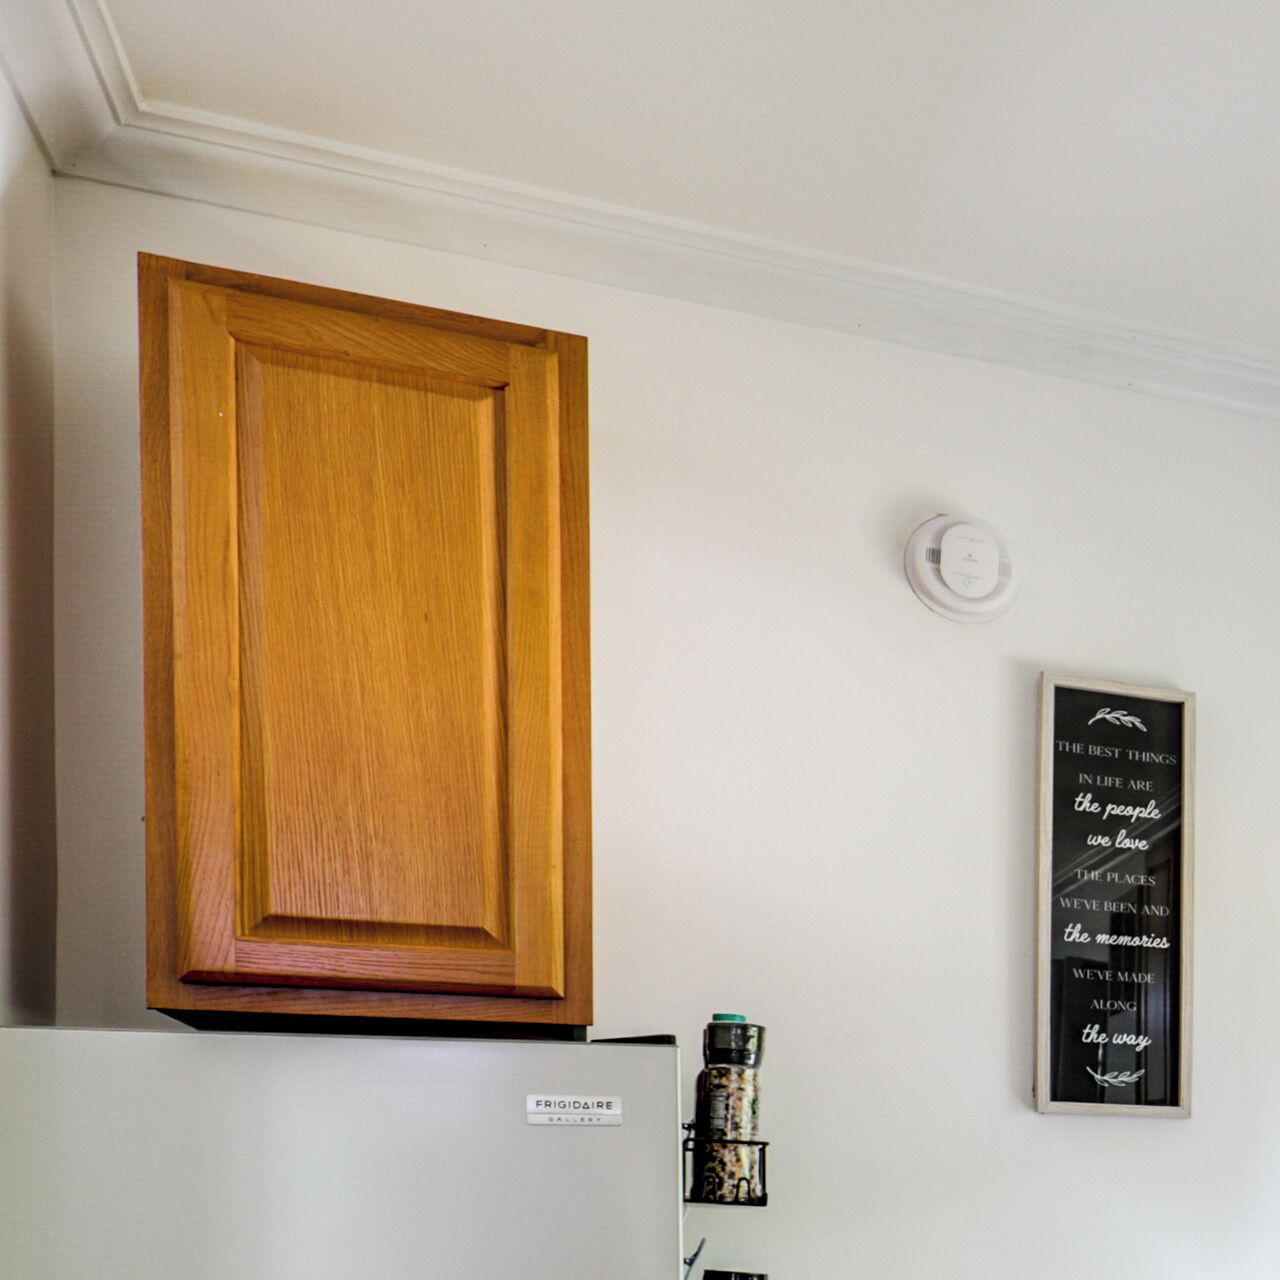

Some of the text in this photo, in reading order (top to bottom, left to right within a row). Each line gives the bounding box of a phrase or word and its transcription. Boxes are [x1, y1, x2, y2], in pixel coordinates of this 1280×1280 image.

[1056, 740, 1177, 765] THE BEST THINGS
[1079, 773, 1153, 792] IN LIFE ARE
[1074, 792, 1161, 822] the people
[1087, 829, 1149, 850] we love
[1074, 869, 1156, 886] THE PLACES
[1059, 897, 1169, 917] WE'VE BEEN AND
[1064, 923, 1170, 949] the memories
[1072, 968, 1155, 984] WE'VE MADE
[1090, 999, 1137, 1012] ALONG
[1082, 1024, 1152, 1052] the way
[536, 1100, 613, 1110] FRIGIDAIRE
